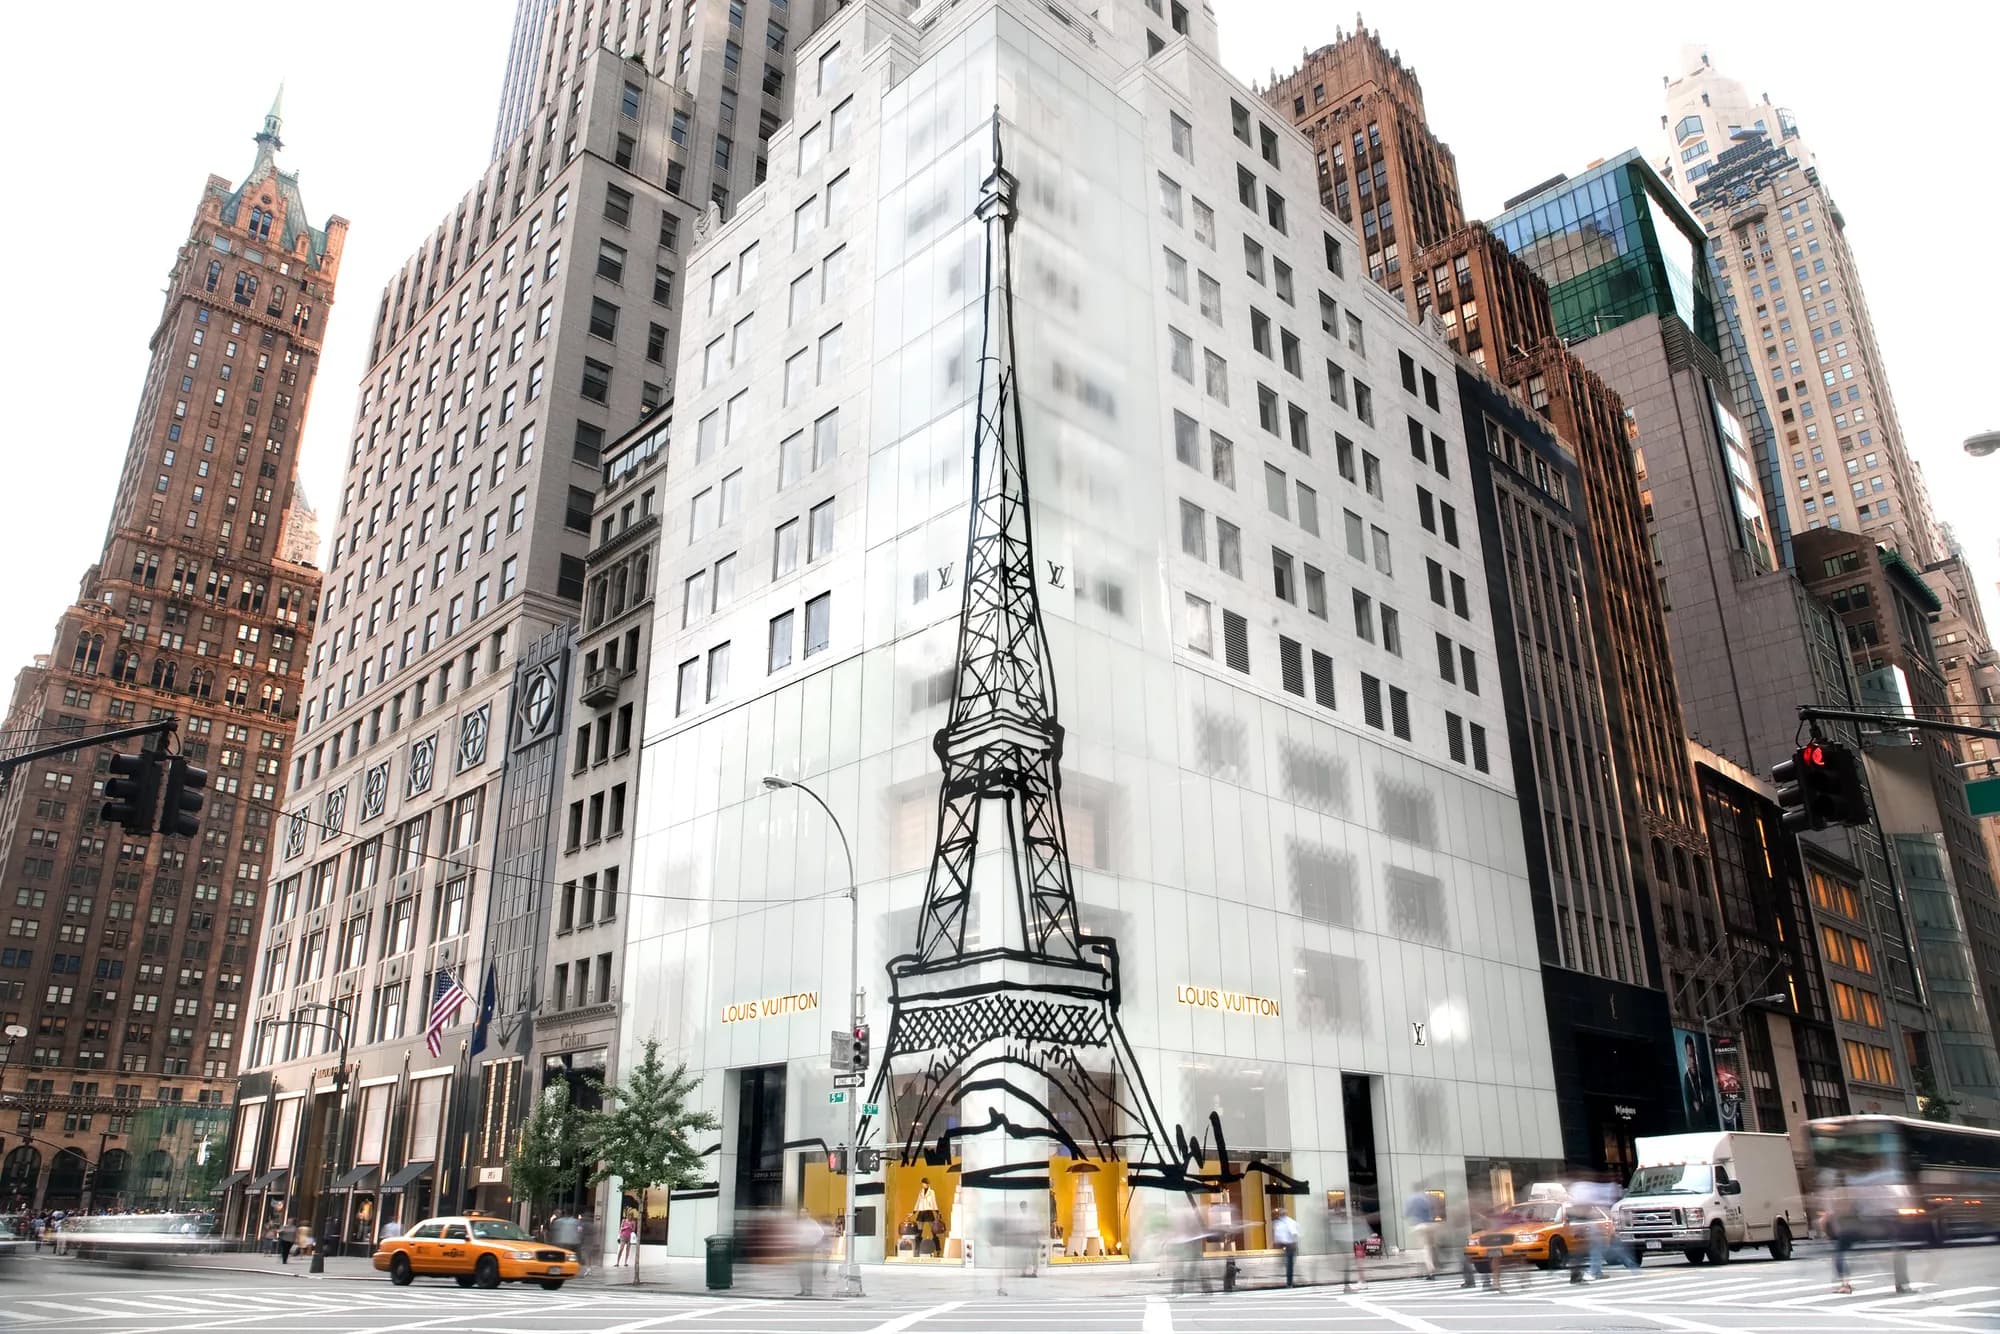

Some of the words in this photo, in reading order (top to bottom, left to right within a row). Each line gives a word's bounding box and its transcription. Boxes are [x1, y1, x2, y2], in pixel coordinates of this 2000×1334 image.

[721, 1002, 757, 1023] LOUIS
[761, 991, 818, 1016] VUITTON
[1177, 986, 1219, 1008] LOUIS
[1223, 993, 1280, 1017] VUITTON
